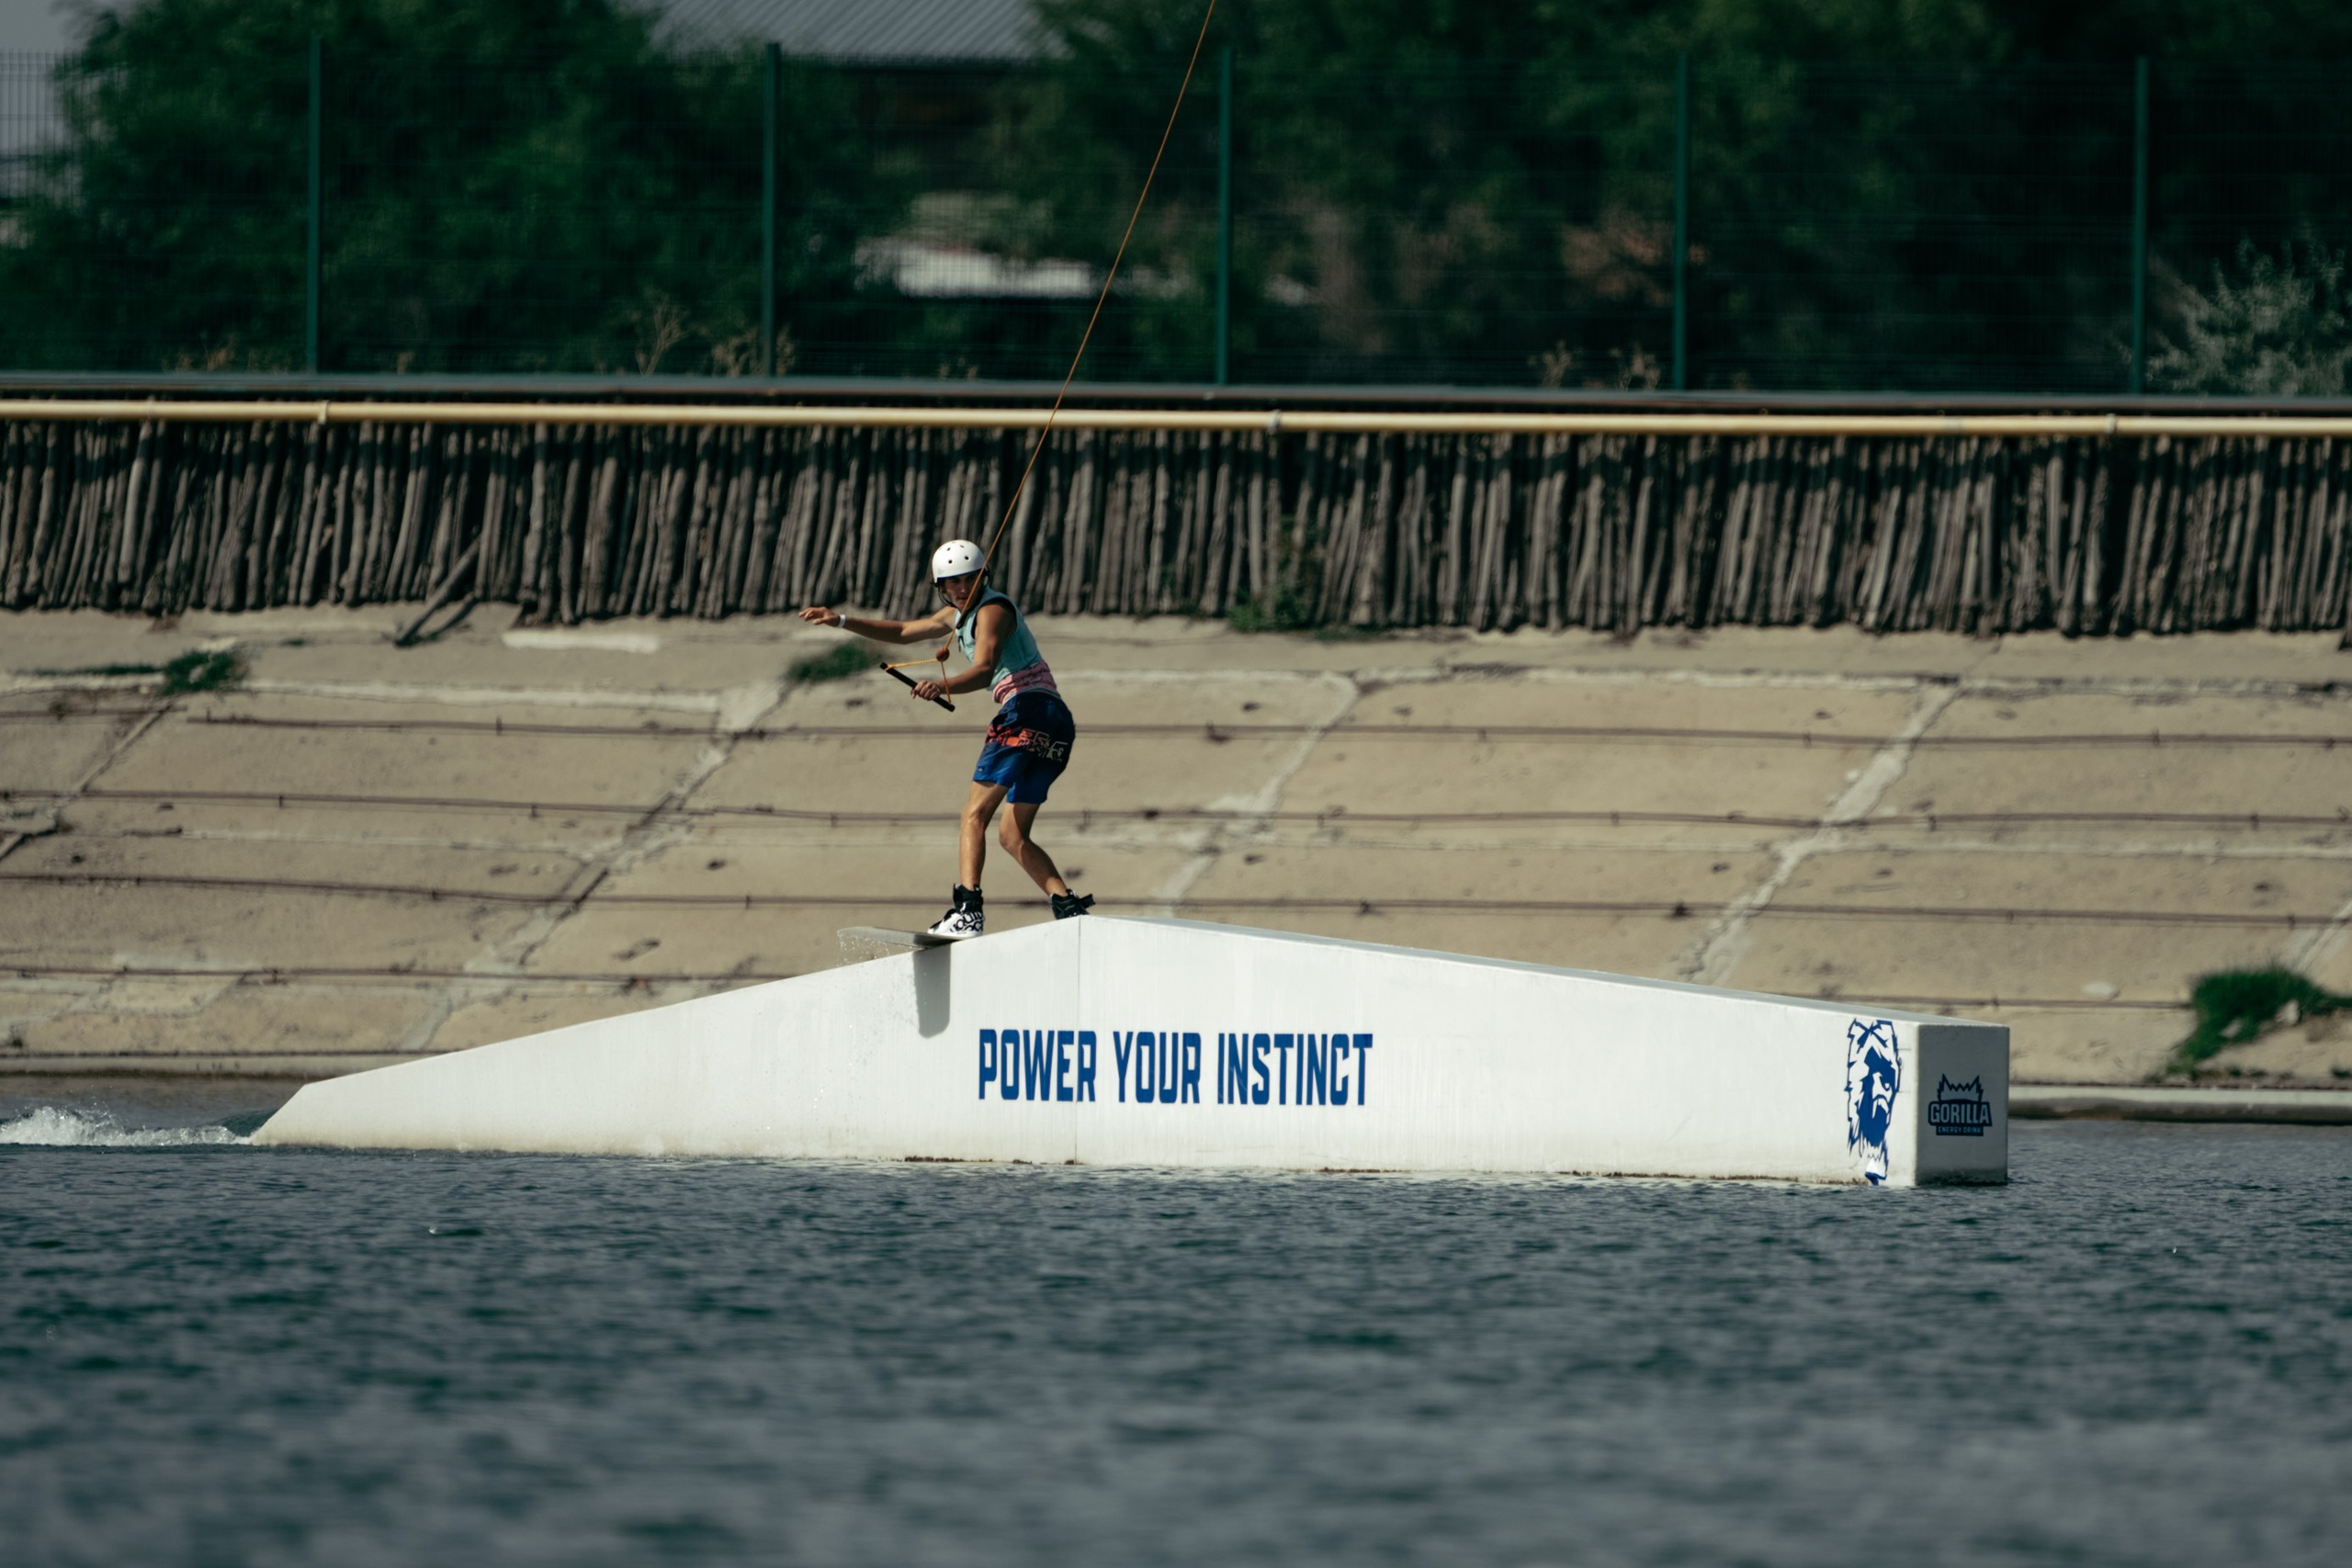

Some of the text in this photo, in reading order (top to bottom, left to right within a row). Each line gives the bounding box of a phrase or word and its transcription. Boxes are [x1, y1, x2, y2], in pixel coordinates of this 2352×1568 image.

[978, 1028, 1374, 1106] POWER YOUR INSTINCT
[1930, 1103, 1990, 1123] GORILLA
